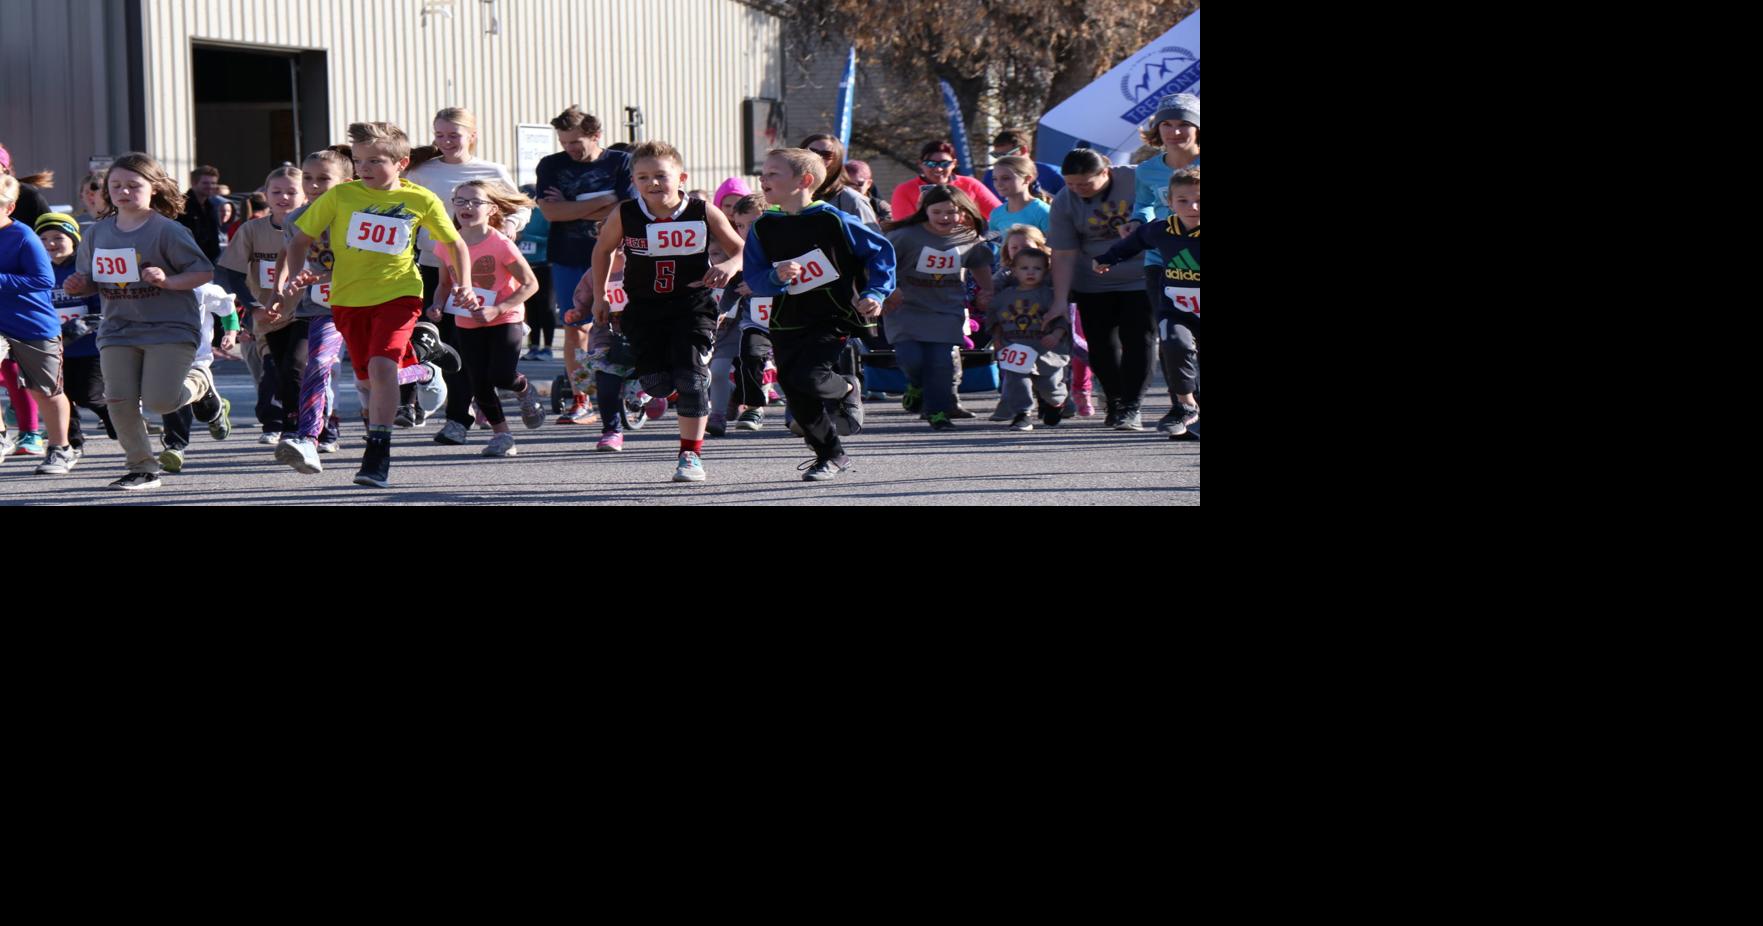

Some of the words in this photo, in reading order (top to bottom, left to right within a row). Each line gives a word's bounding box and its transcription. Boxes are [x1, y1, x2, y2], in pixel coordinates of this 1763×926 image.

[358, 221, 398, 246] 501
[657, 229, 697, 249] 502
[96, 257, 128, 275] 530
[926, 255, 955, 269] 531
[791, 260, 824, 286] 20
[606, 288, 625, 305] 50
[1175, 295, 1200, 314] 51
[1000, 348, 1028, 366] 503
